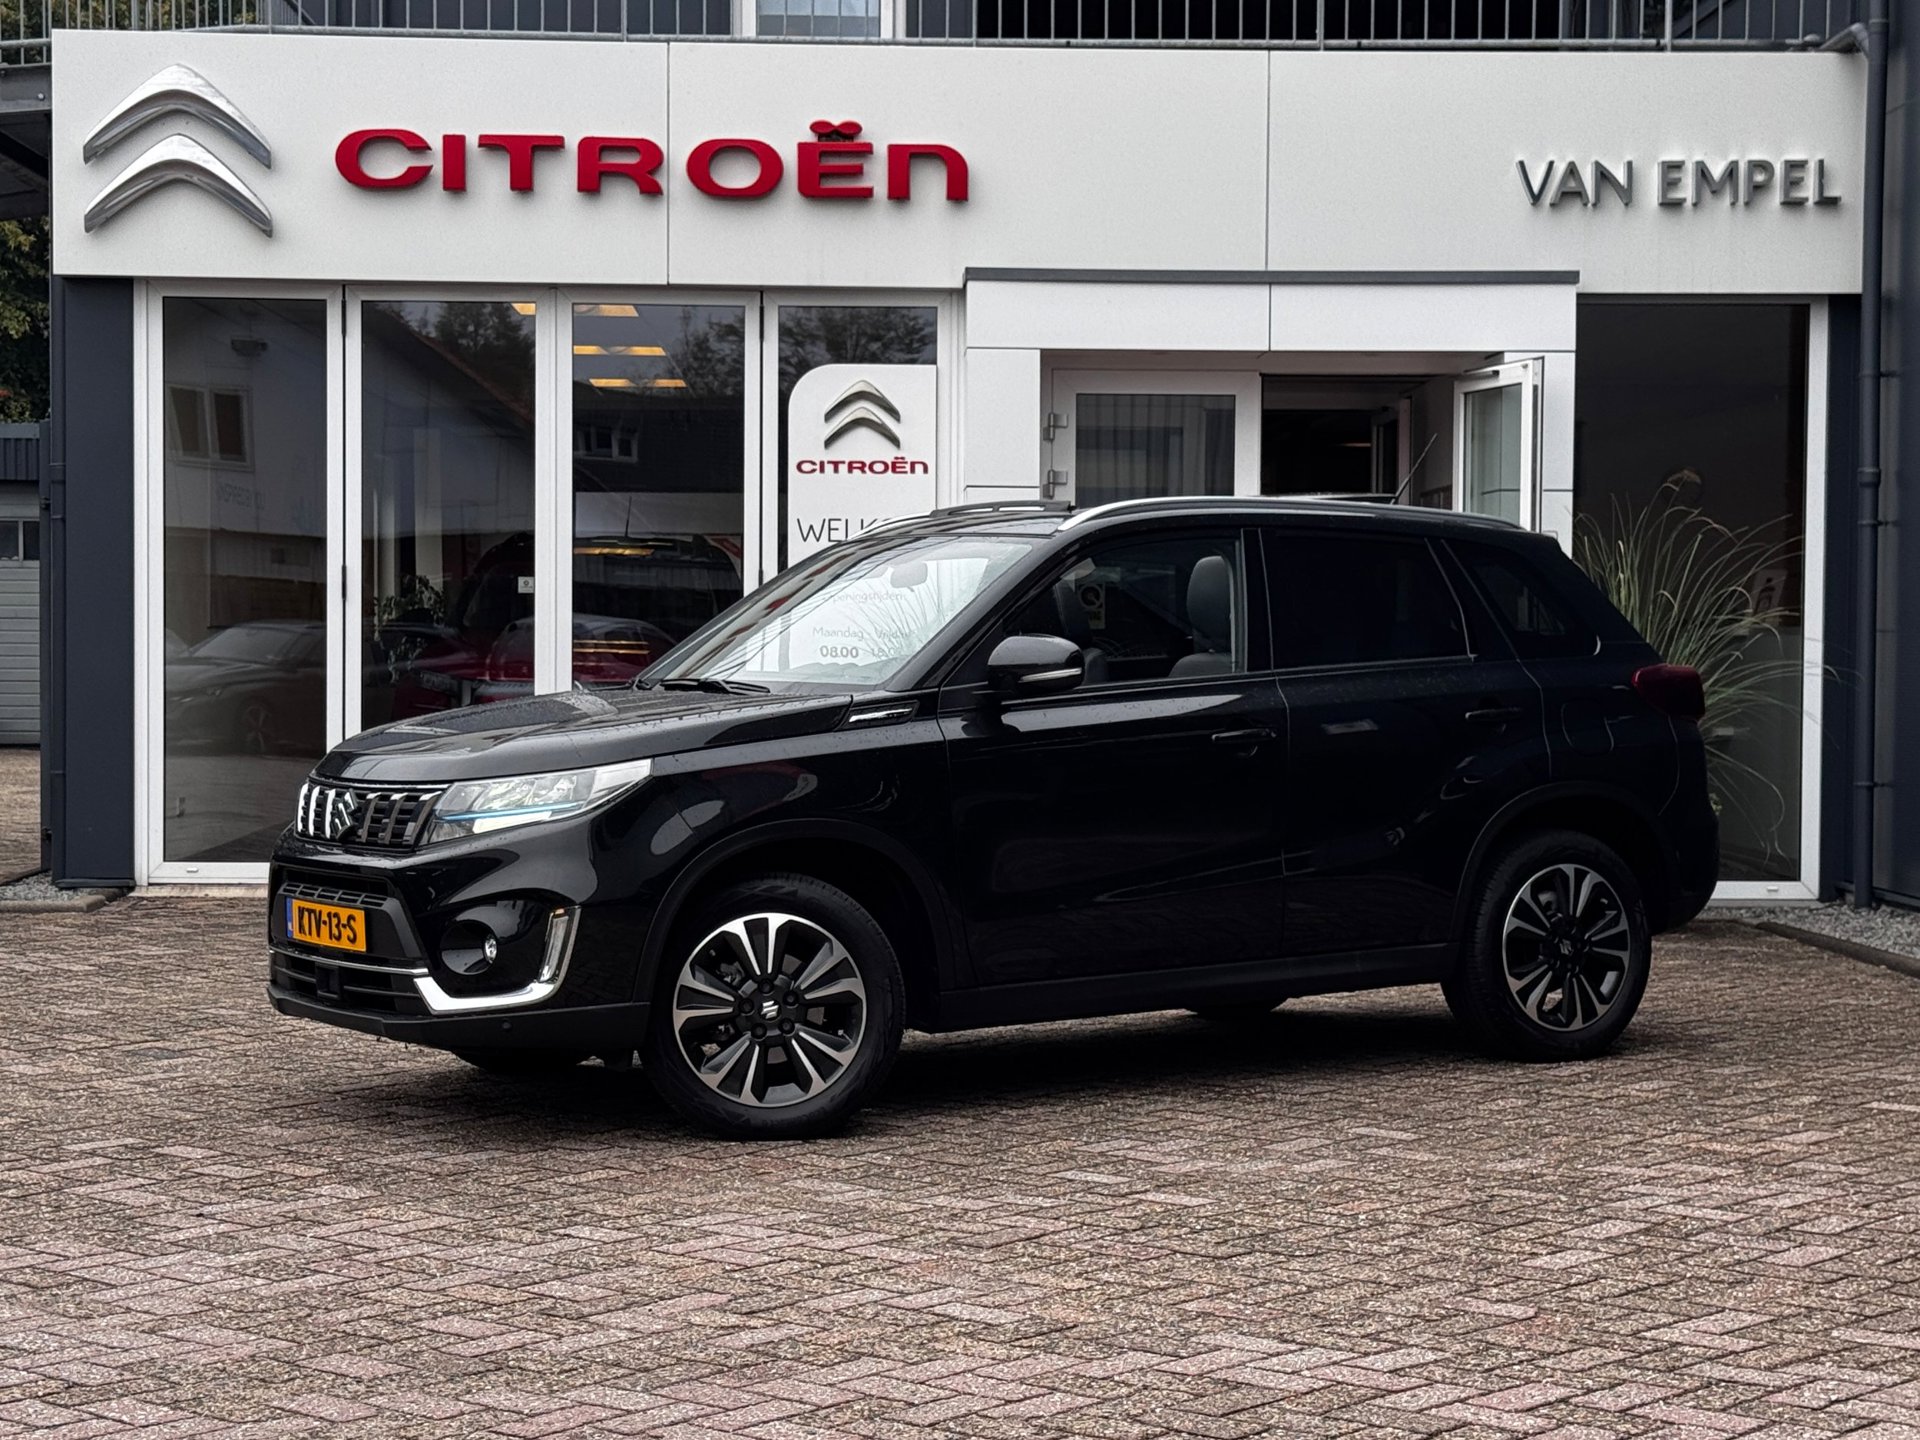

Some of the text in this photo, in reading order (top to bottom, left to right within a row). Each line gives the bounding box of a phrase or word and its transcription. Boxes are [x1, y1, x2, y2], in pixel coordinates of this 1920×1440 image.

[335, 120, 969, 202] CITROËN
[1515, 158, 1842, 206] VAN EMPEL
[796, 456, 929, 475] CITROËN
[812, 626, 864, 642] Maandag
[297, 905, 358, 945] KTV-13-S
